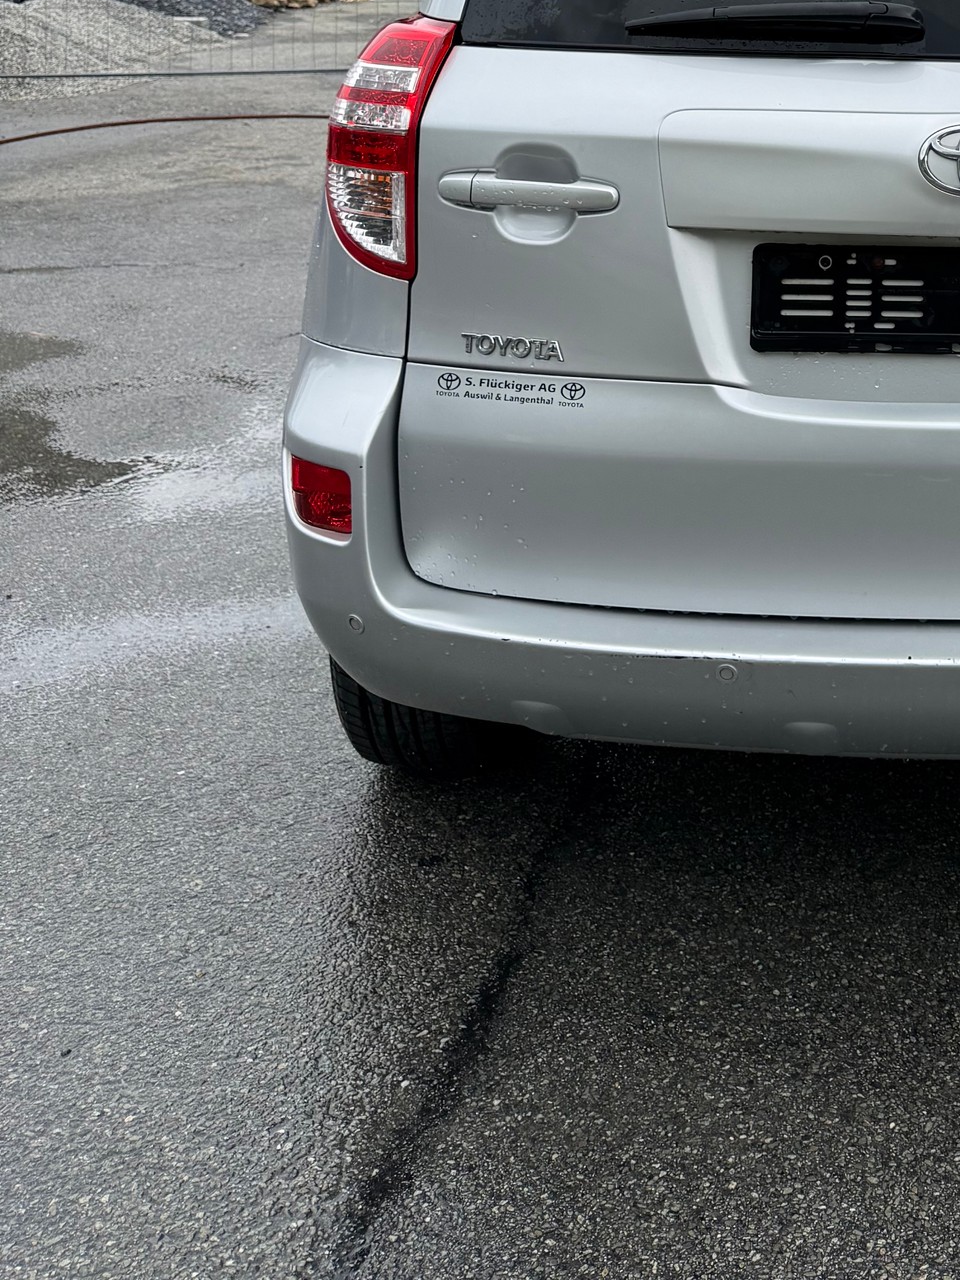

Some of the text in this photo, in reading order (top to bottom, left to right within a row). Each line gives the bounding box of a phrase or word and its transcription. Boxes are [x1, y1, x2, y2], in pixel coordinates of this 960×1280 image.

[461, 332, 564, 362] TOYOTA
[465, 377, 556, 393] S. Flückiger AG
[436, 390, 460, 398] TOYOTA
[463, 391, 493, 400] Auswil
[504, 394, 554, 406] Langenthal
[558, 401, 584, 409] TOYOTA
